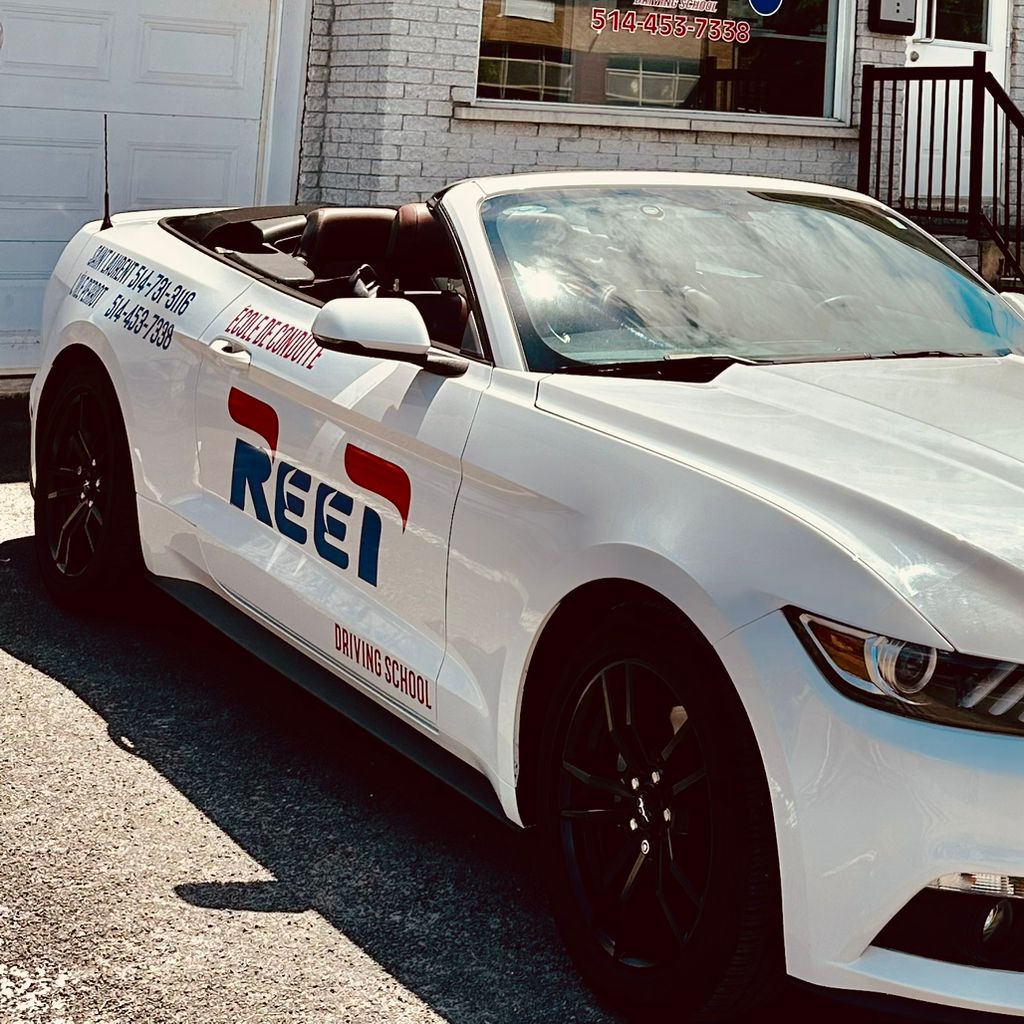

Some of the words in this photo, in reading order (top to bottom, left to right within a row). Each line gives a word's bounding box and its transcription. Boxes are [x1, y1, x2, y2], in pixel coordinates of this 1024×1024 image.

[590, 7, 751, 44] 514-453-7338
[127, 265, 196, 317] 514-731-3116
[104, 294, 175, 351] 514-453-7338
[224, 304, 270, 342] ÉCOLE
[252, 317, 282, 347] DE
[228, 386, 412, 588] REET
[334, 622, 382, 678] DRIVING
[384, 655, 432, 710] SCHOOL
